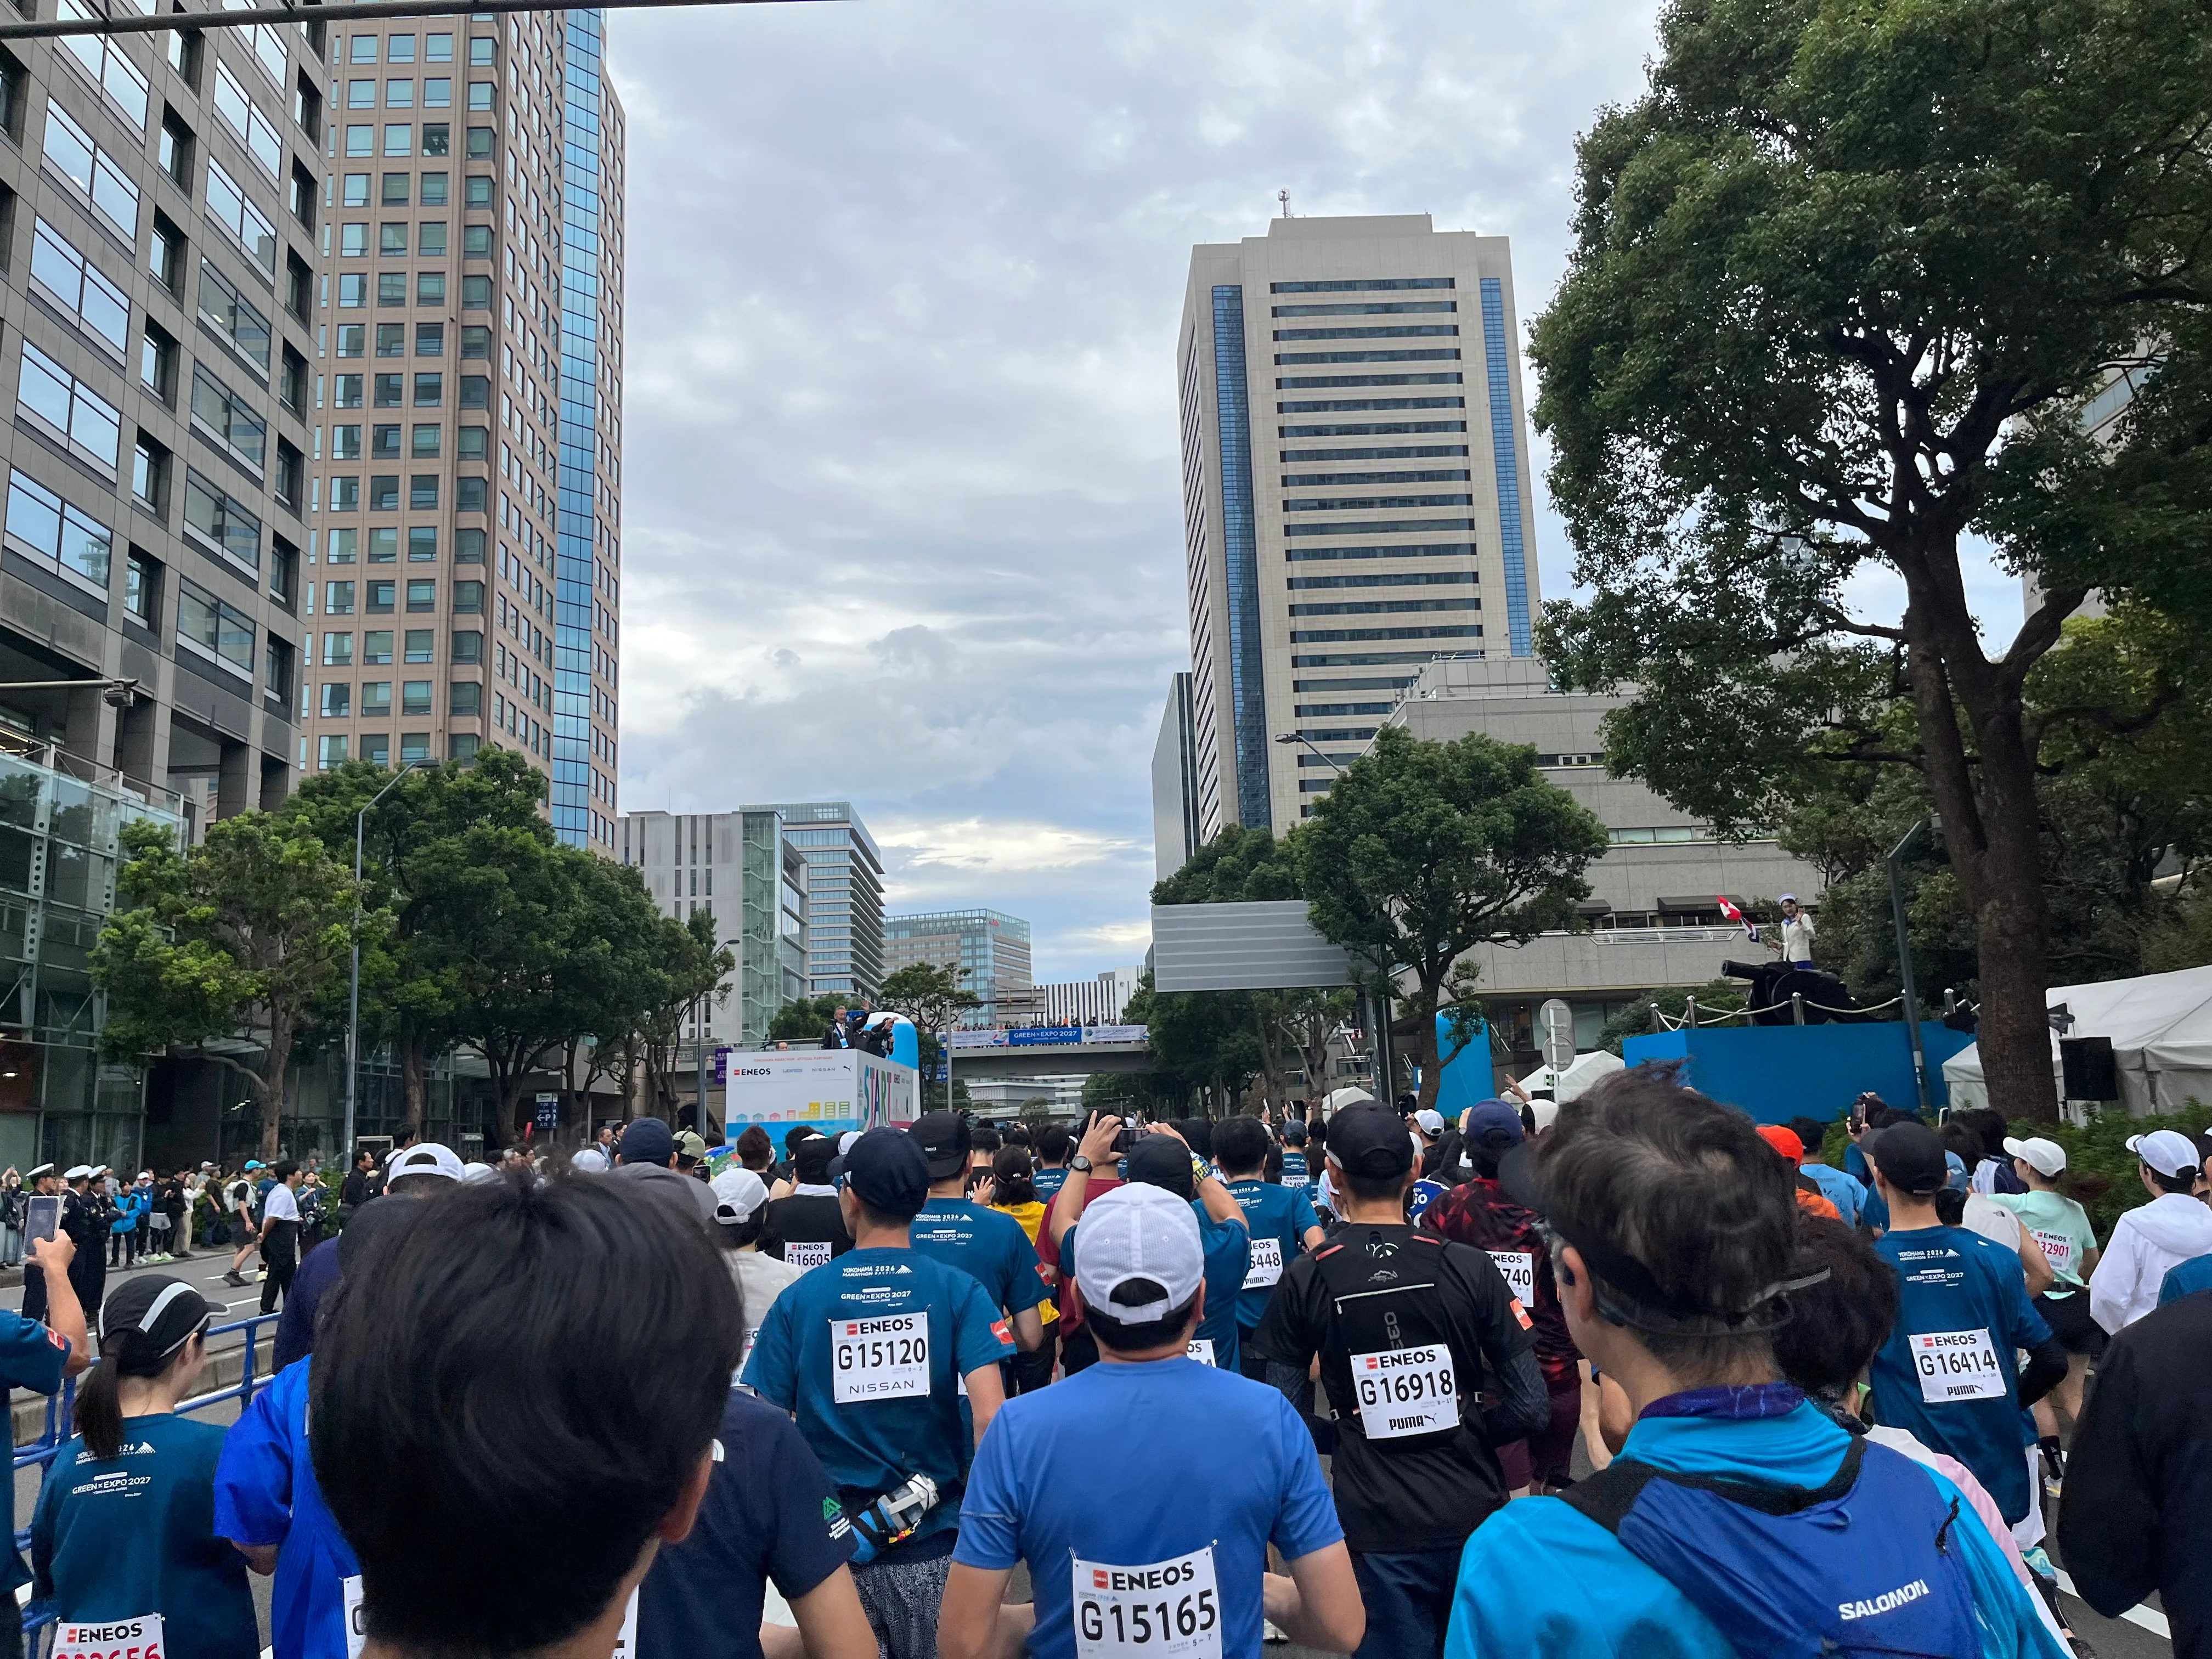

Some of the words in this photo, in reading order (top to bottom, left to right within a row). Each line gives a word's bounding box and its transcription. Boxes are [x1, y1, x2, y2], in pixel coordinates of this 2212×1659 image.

[864, 1065, 891, 1127] START
[2044, 1233, 2067, 1242] ENEOS
[2034, 1240, 2069, 1258] 32901
[787, 1254, 830, 1266] G16605
[1490, 1254, 1522, 1263] NEOS
[1501, 1268, 1531, 1286] 740
[860, 1318, 913, 1334] ENEOS
[1935, 1334, 1977, 1346] ENEOS
[838, 1338, 926, 1370] G15120
[1379, 1350, 1436, 1368] ENEOS
[1920, 1350, 1996, 1376] G16414
[850, 1380, 914, 1394] NISSAN
[1361, 1369, 1453, 1405] G16918
[1946, 1385, 1976, 1396] PUMA
[1389, 1415, 1424, 1430] PUMA
[128, 1476, 151, 1486] 2027
[1111, 1561, 1194, 1590] ENEOS
[1838, 1578, 1930, 1620] SALOMON
[1081, 1589, 1216, 1644] G15165
[78, 1622, 143, 1643] ENEOS
